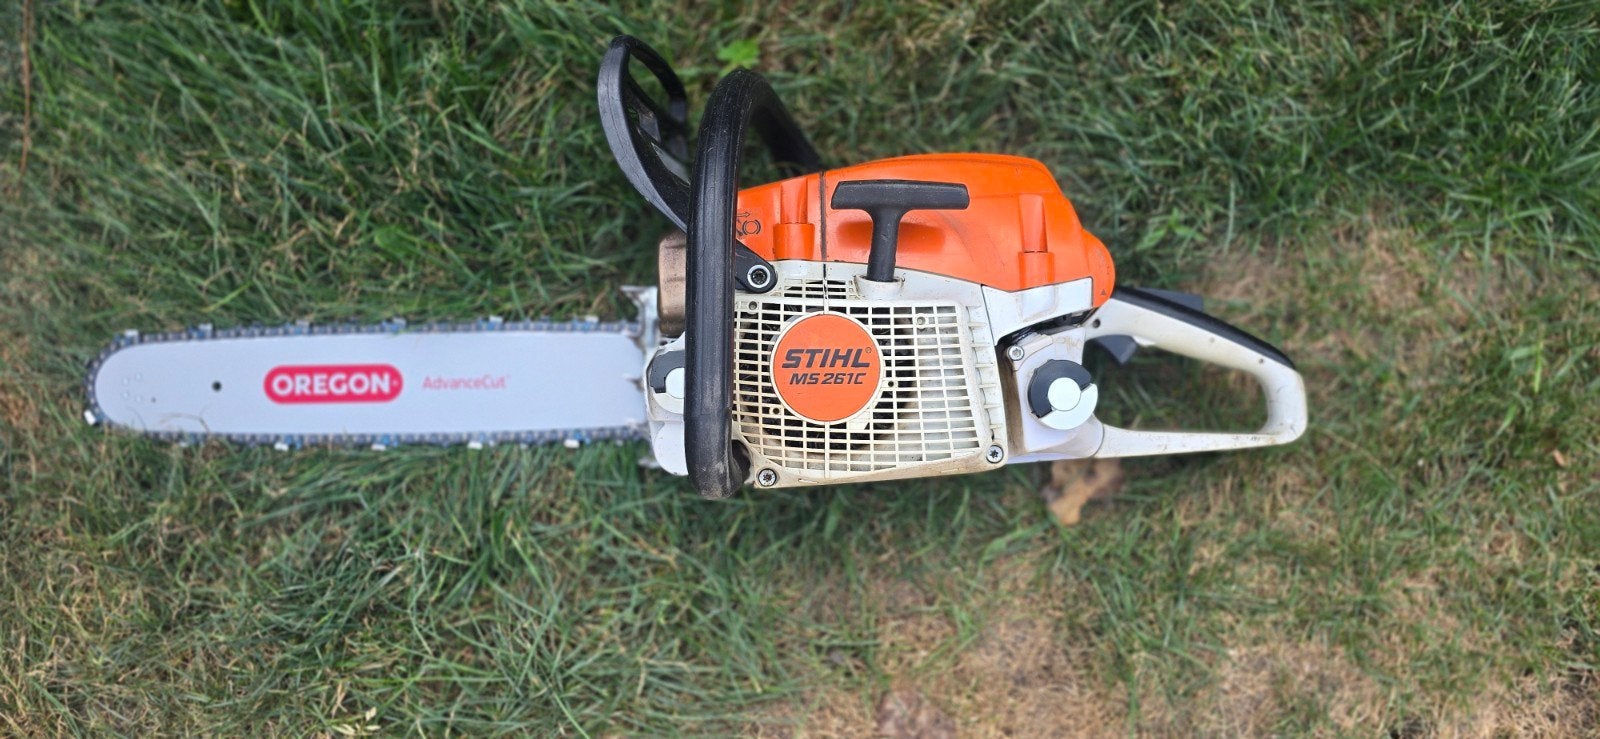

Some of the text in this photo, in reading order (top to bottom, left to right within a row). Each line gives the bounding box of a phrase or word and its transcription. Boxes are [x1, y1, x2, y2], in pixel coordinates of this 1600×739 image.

[782, 348, 870, 369] STIHL
[272, 373, 391, 397] OREGON
[422, 375, 507, 390] AdvanceCut
[789, 373, 866, 385] MS 261C
